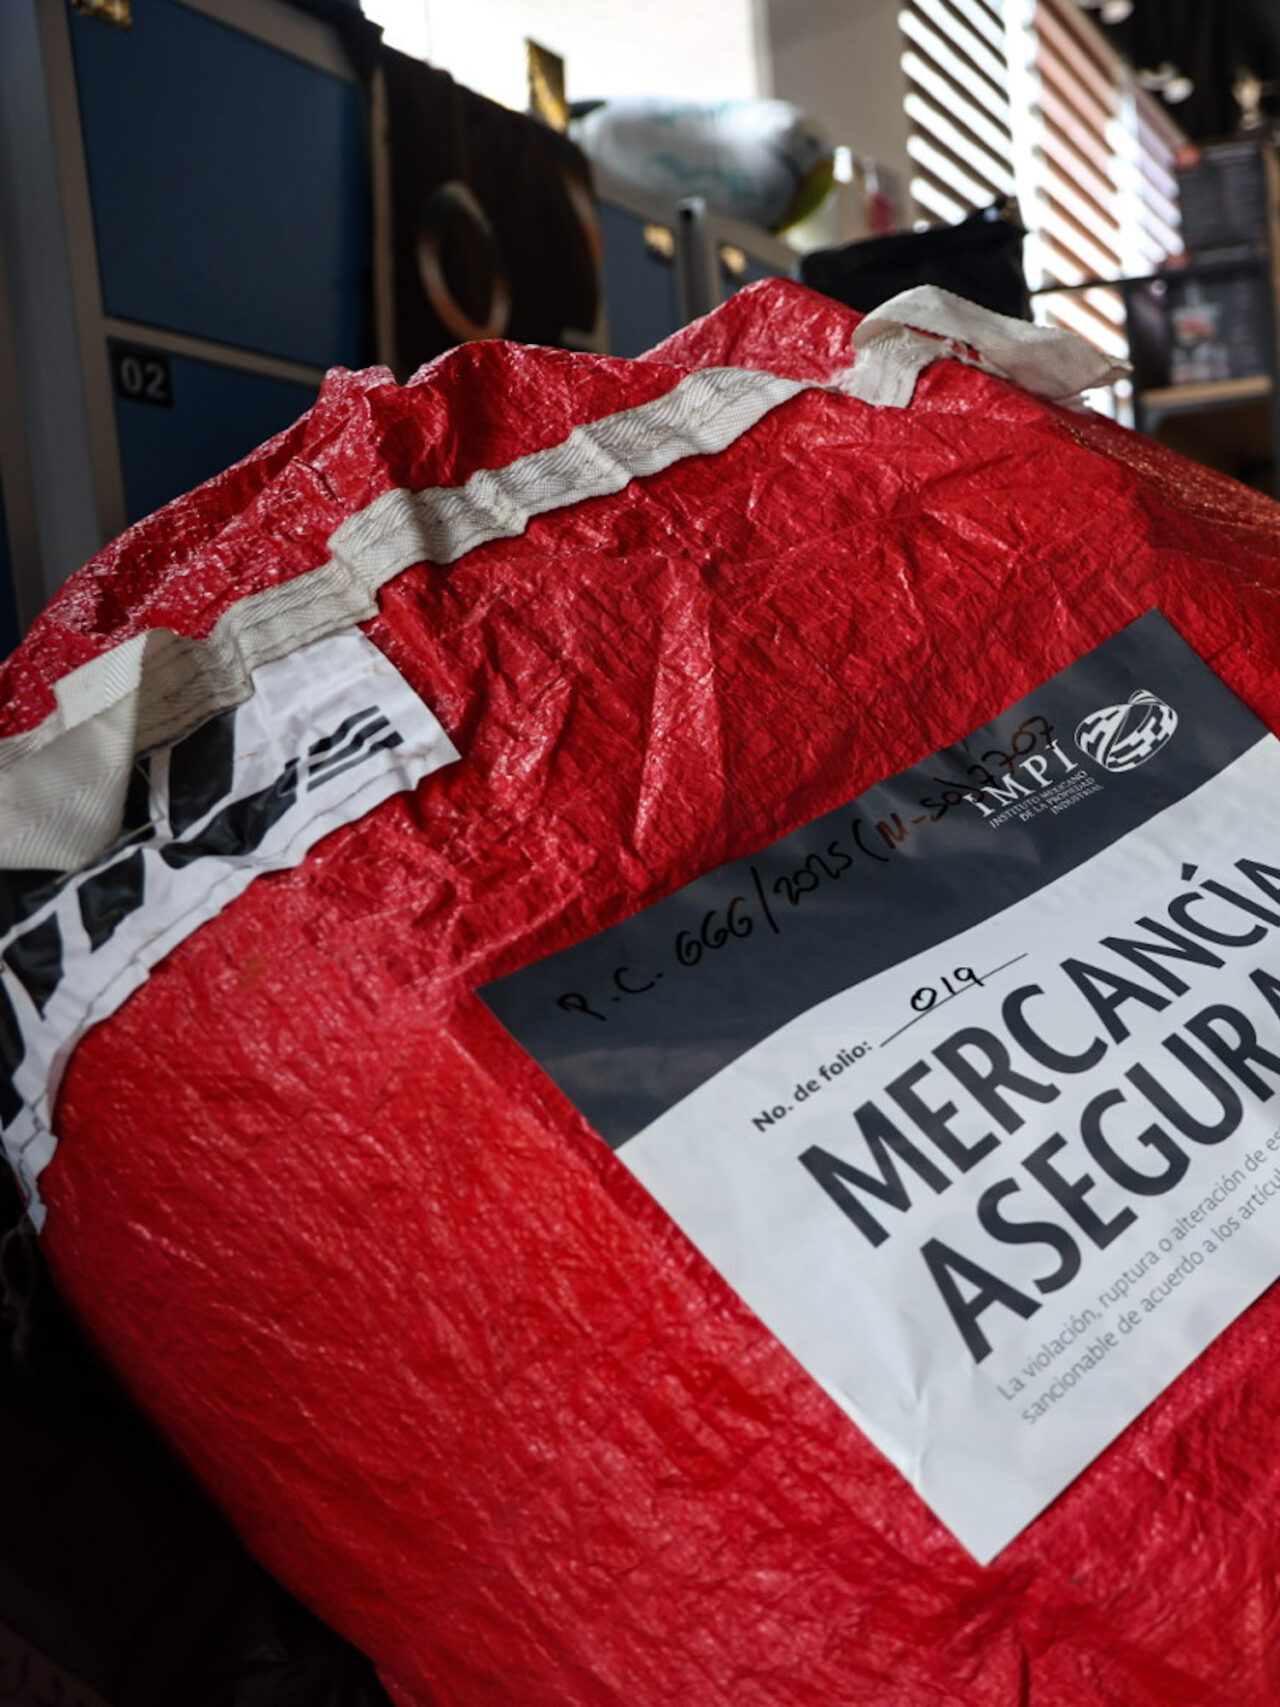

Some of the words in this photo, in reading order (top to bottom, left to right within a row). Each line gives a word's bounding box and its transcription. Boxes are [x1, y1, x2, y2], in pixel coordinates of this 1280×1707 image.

[121, 357, 169, 400] 02
[962, 739, 1078, 817] IMPI
[989, 793, 1041, 831] INSTITUTO
[1039, 769, 1088, 802] MEXICANO
[909, 966, 984, 1012] 019
[751, 1101, 794, 1132] No.
[793, 1078, 821, 1103] de
[818, 1041, 872, 1082] folio:
[997, 1376, 1025, 1401] La
[1023, 1307, 1103, 1378] violación,
[1099, 1251, 1160, 1309] ruptura
[1158, 1237, 1173, 1253] o
[1169, 1167, 1246, 1241] alteración
[1244, 1149, 1267, 1173] de
[1021, 1331, 1119, 1425] sancionable
[1117, 1310, 1142, 1335] de
[1140, 1250, 1204, 1313] acuerdo
[1202, 1238, 1218, 1254] a
[1211, 1216, 1240, 1242] los
